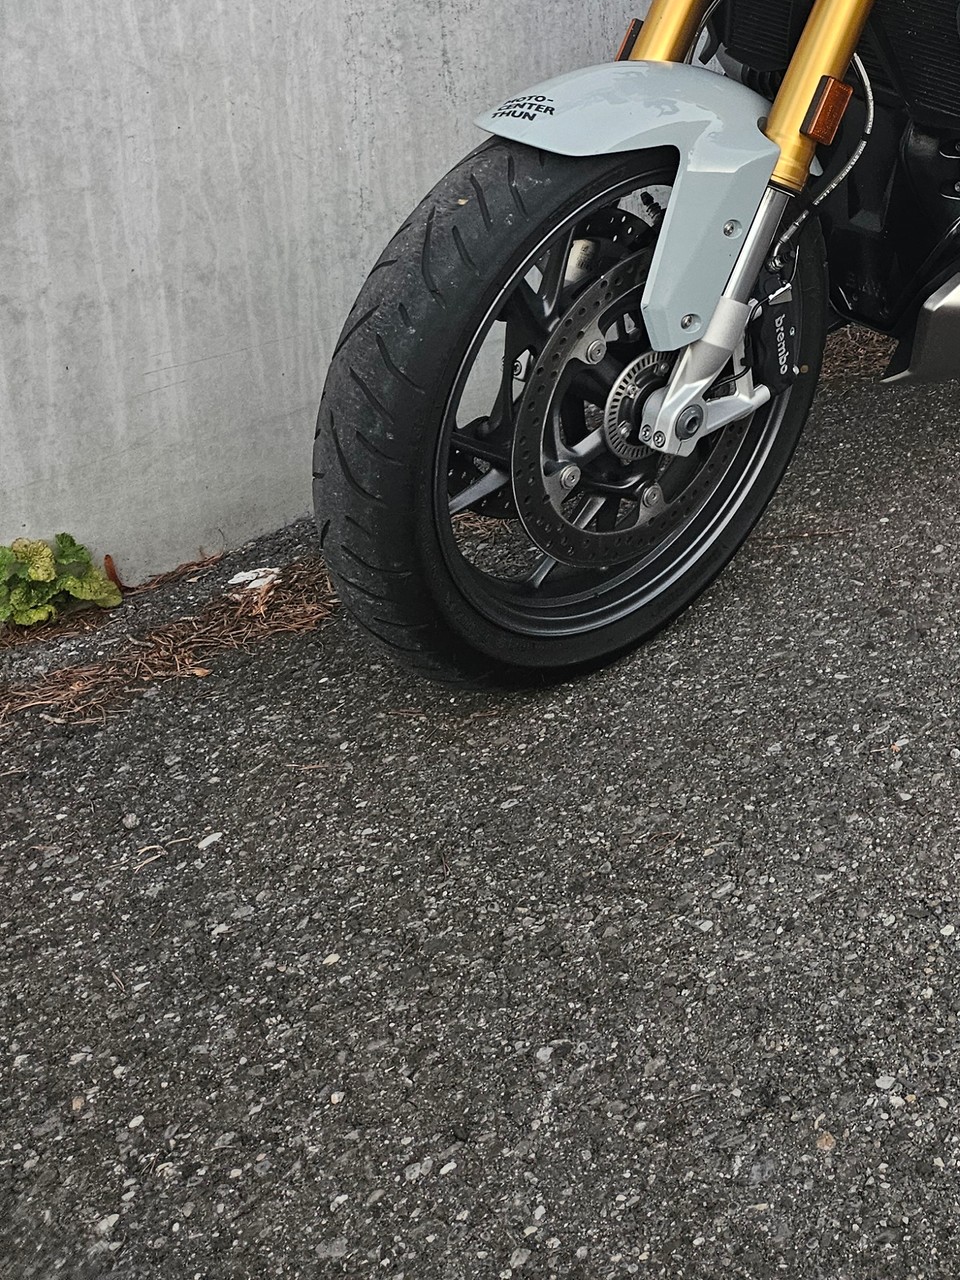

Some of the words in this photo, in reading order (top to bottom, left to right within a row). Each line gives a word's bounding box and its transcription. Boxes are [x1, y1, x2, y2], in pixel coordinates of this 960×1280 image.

[503, 95, 554, 105] MOTO-
[498, 102, 555, 115] CENTER
[491, 110, 536, 121] THUN
[775, 313, 789, 374] brembo
